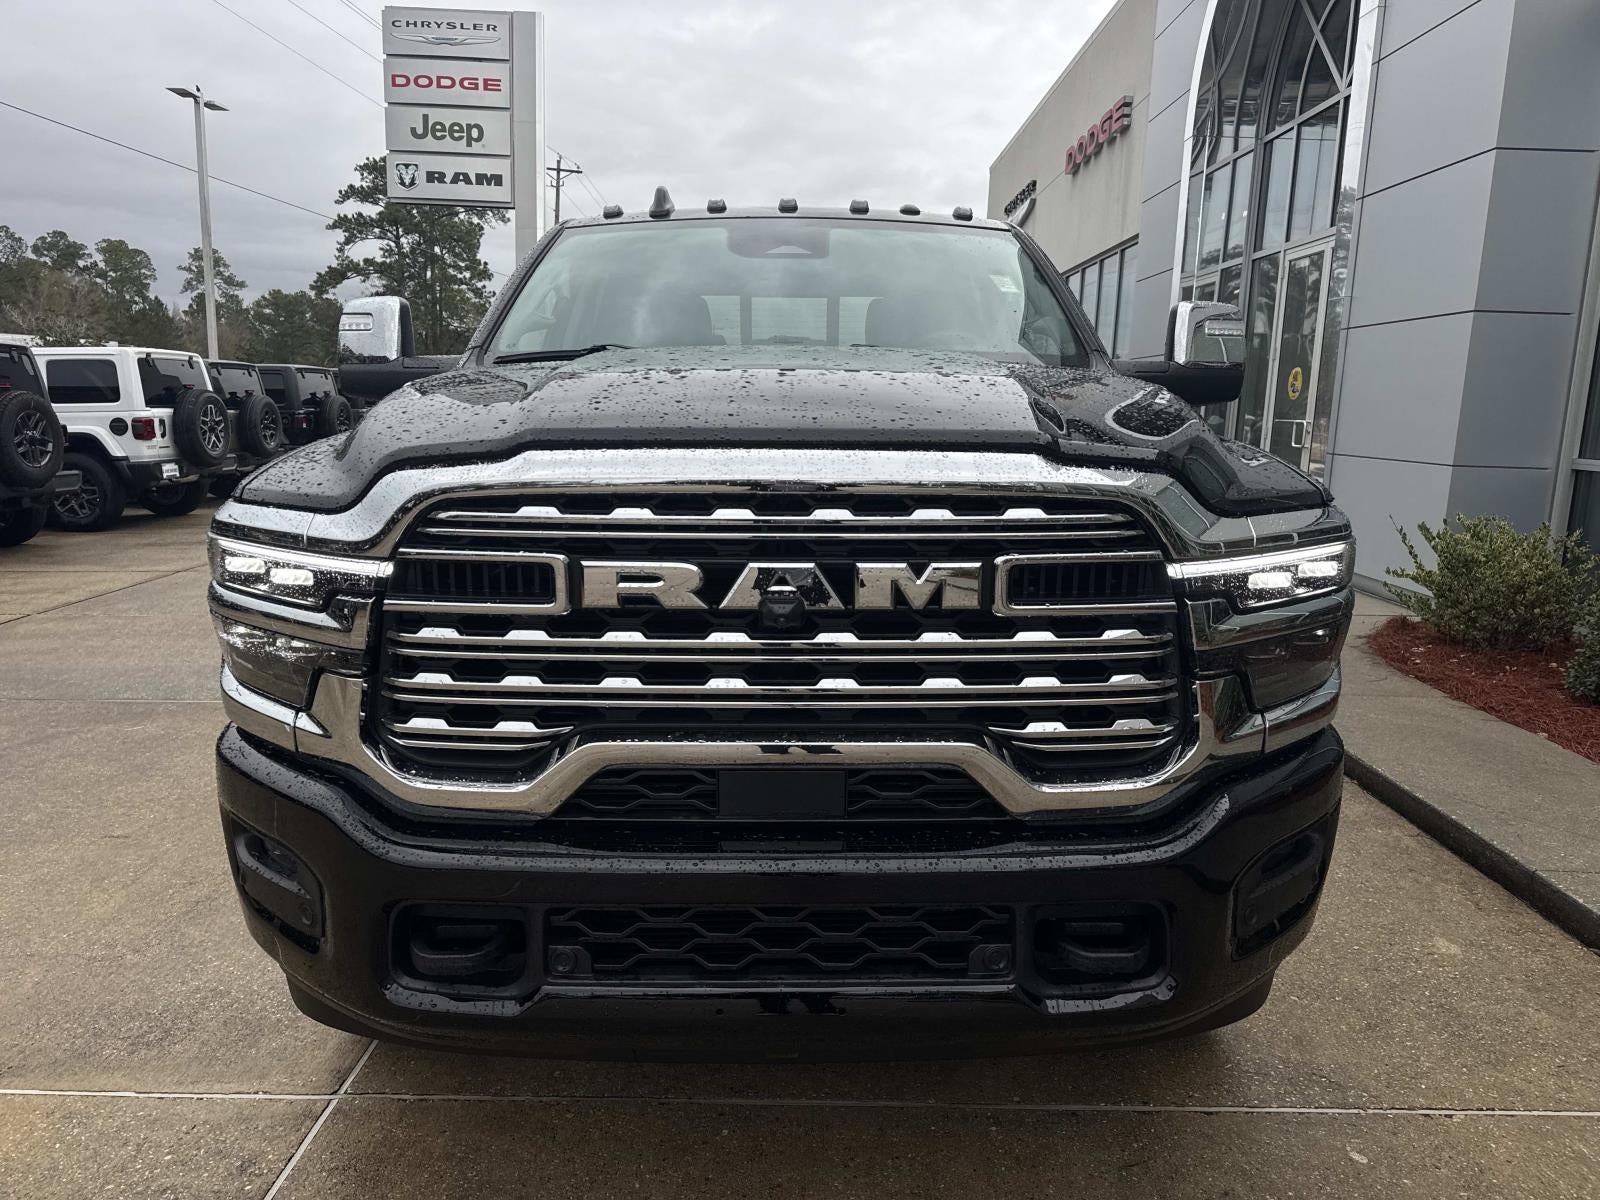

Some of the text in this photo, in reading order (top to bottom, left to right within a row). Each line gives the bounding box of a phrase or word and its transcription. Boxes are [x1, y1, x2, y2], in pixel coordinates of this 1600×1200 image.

[391, 19, 498, 32] CHRYSLER
[391, 74, 502, 92] DODGE
[409, 113, 485, 148] Jeep
[1064, 95, 1134, 175] DODGE
[425, 170, 503, 187] RAM
[579, 560, 983, 610] RAM
